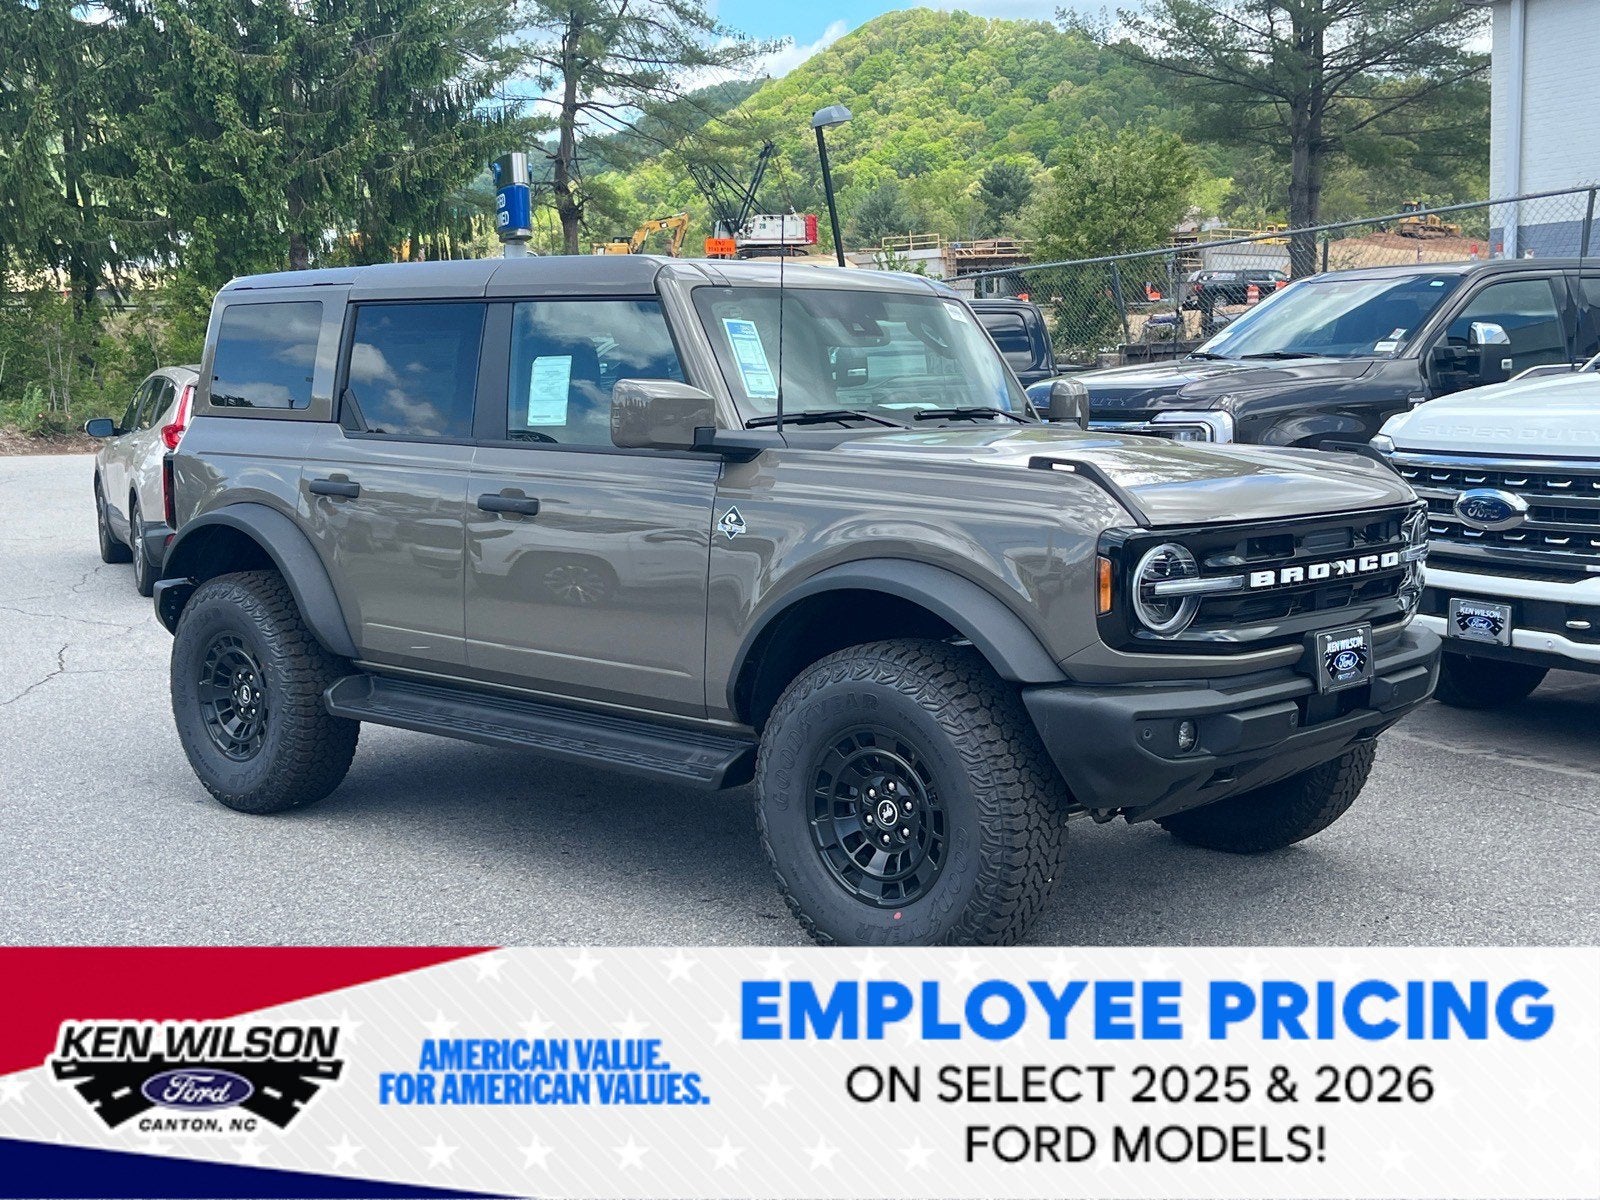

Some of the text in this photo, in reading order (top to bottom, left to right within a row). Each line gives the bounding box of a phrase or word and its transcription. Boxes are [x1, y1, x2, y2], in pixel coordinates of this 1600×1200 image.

[1417, 423, 1515, 440] SUPER
[1467, 500, 1499, 519] Ford
[1250, 552, 1399, 588] BRONCO
